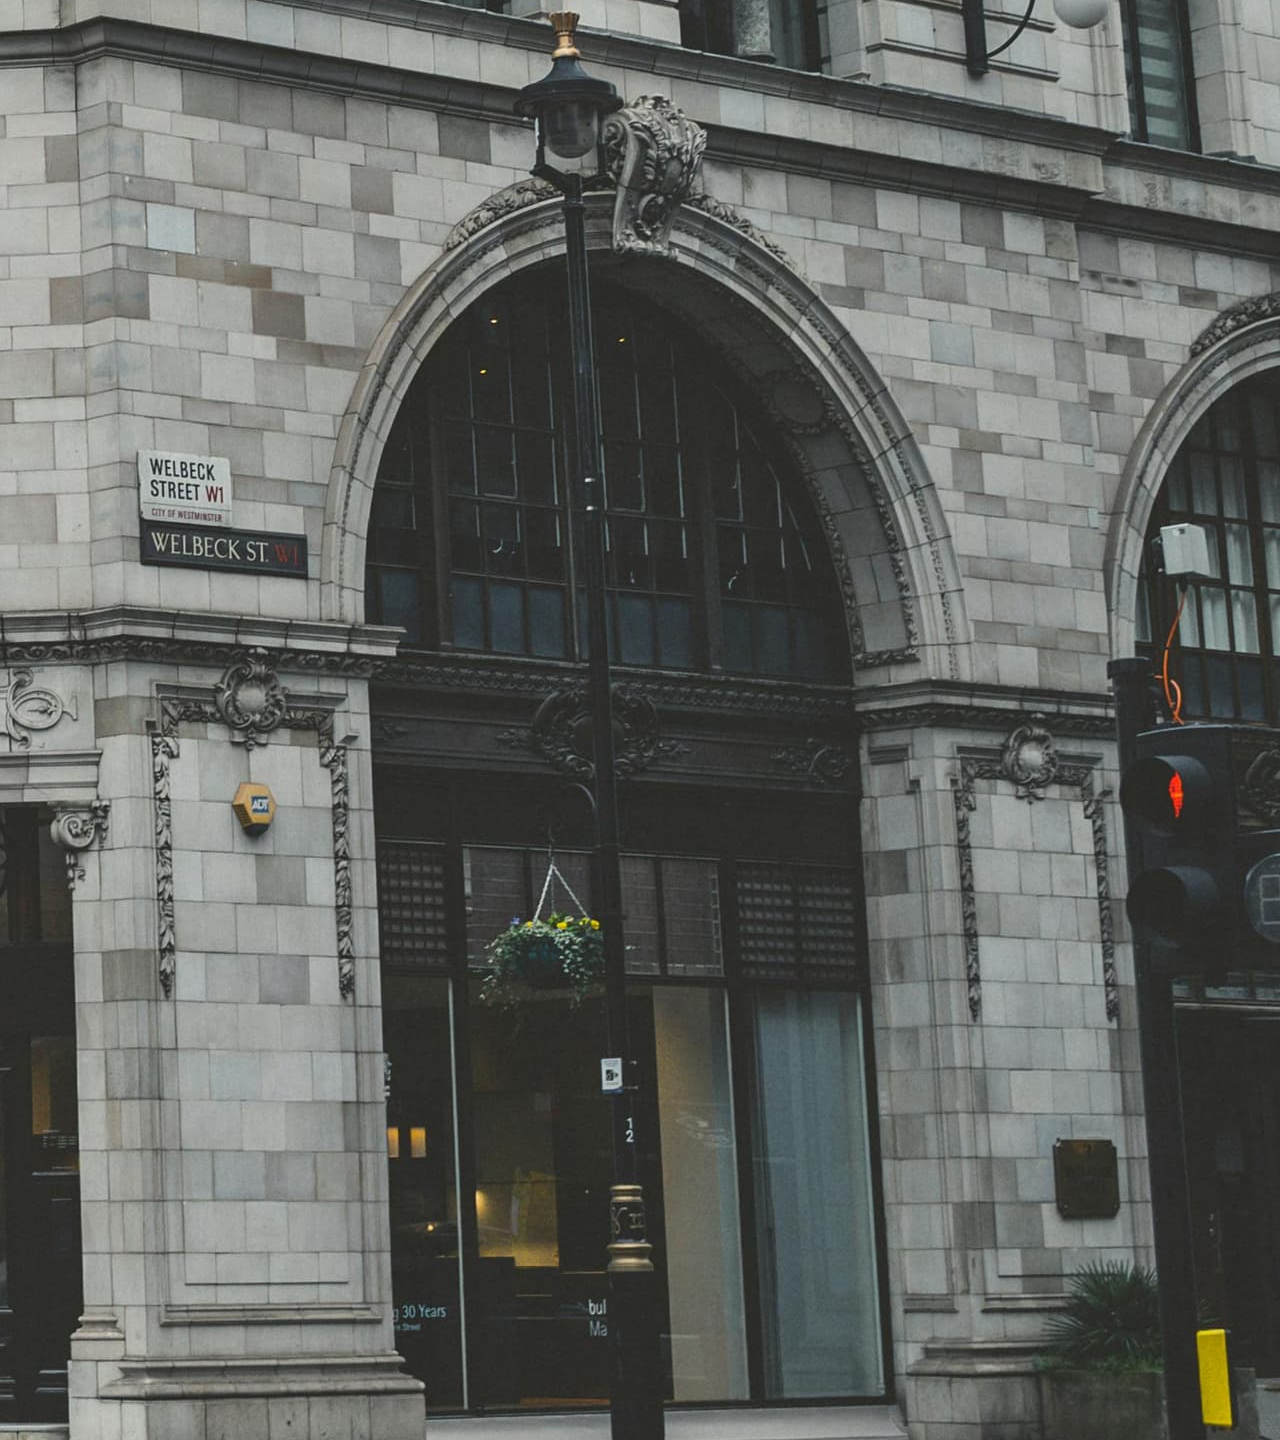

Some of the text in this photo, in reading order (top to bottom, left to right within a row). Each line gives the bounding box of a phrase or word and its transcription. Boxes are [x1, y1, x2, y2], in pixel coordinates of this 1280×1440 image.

[150, 458, 215, 481] WELBECK
[151, 480, 224, 504] STREET W1
[151, 508, 222, 522] CITY OF WESTMINSTER
[151, 532, 241, 561] WELBECK
[246, 541, 269, 562] ST.
[252, 798, 269, 810] ADT
[402, 1305, 416, 1319] 30
[418, 1304, 446, 1318] Years
